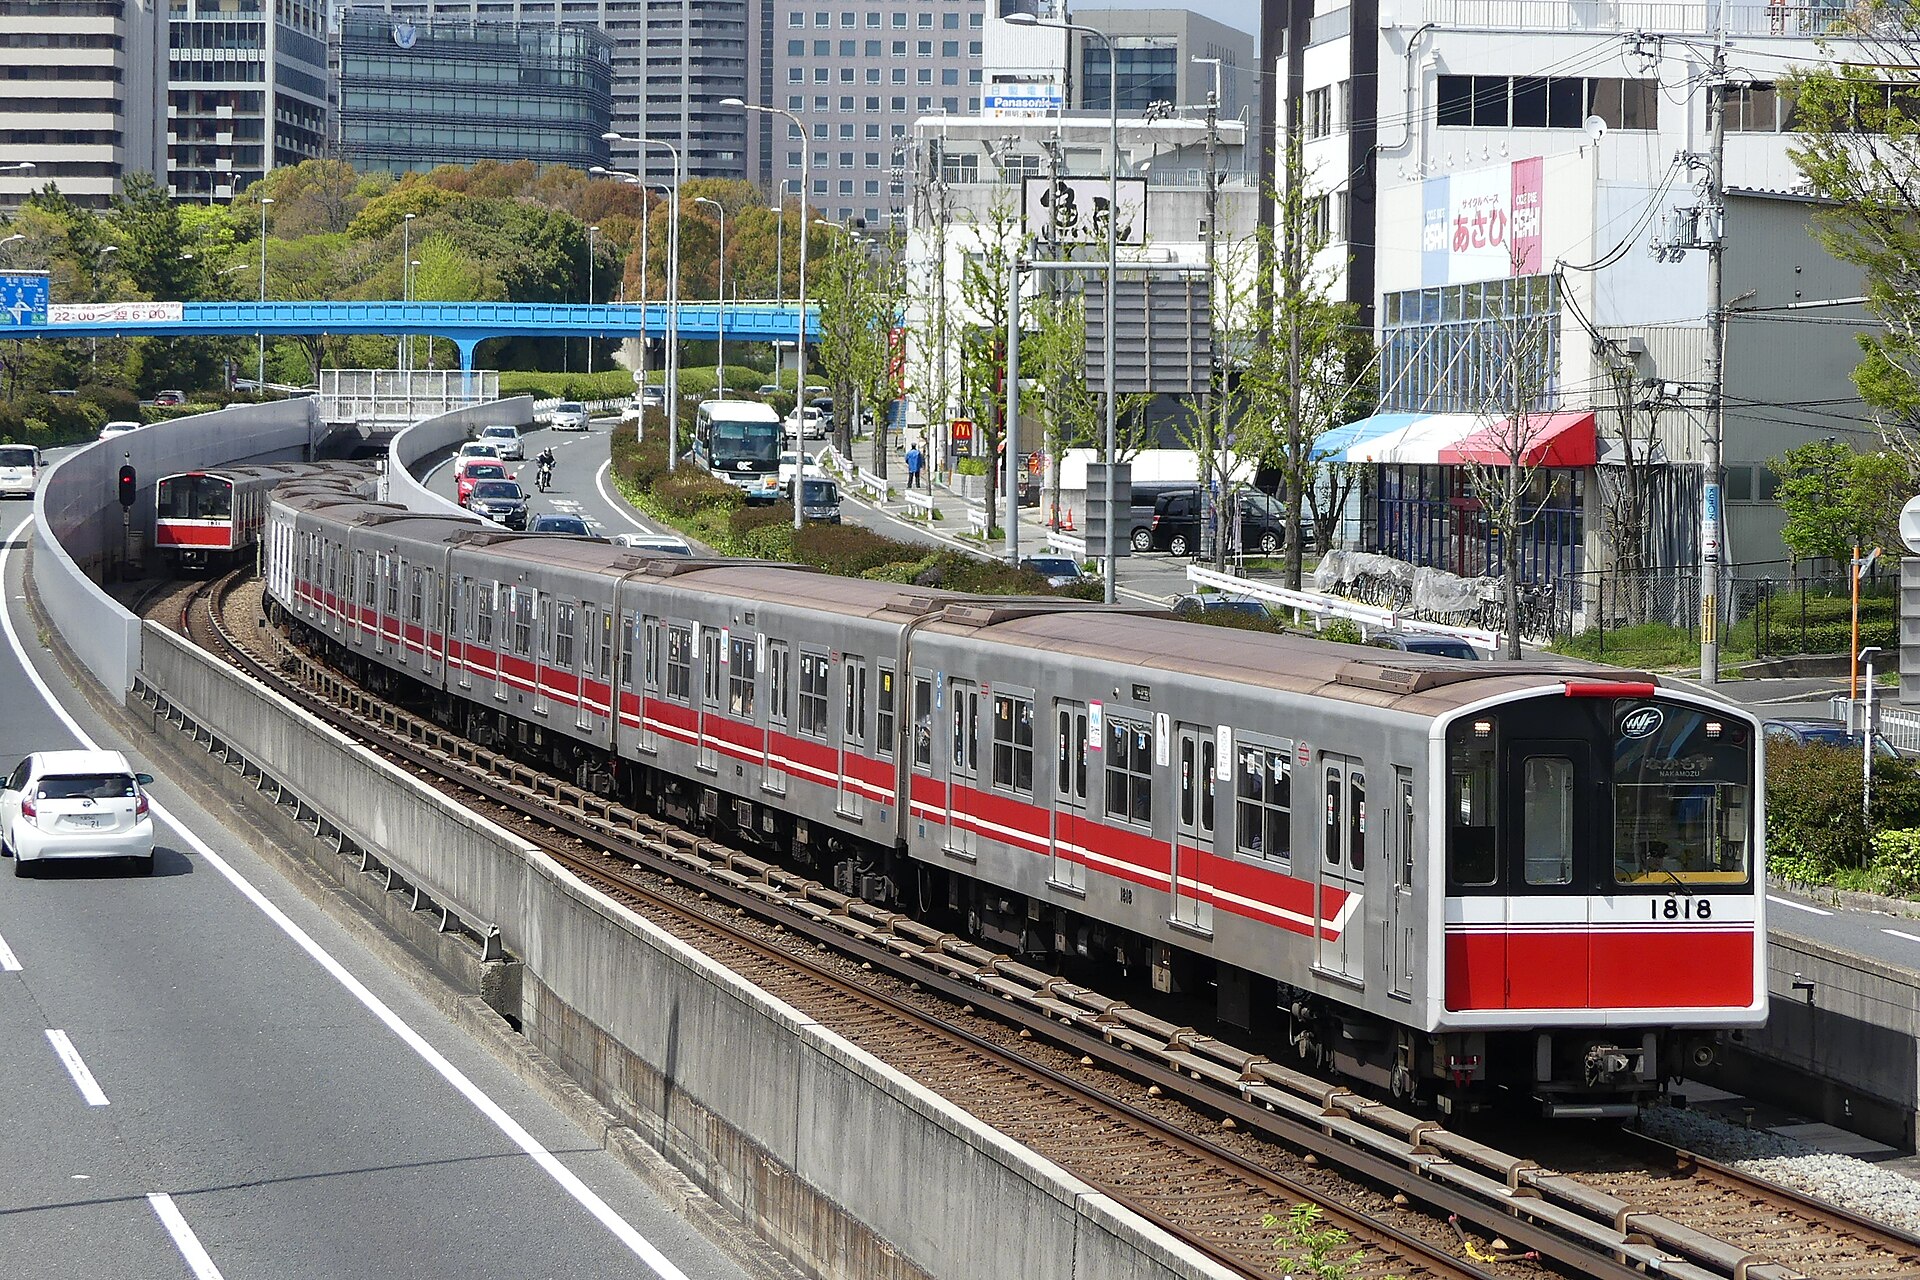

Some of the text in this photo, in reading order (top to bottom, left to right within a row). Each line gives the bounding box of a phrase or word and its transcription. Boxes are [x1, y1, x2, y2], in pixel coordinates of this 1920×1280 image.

[994, 97, 1051, 108] Panasonic
[1462, 193, 1500, 209] サイクルベース
[1453, 208, 1507, 252] あさひ
[1707, 489, 1716, 520] KUMON
[1651, 899, 1712, 919] 1818
